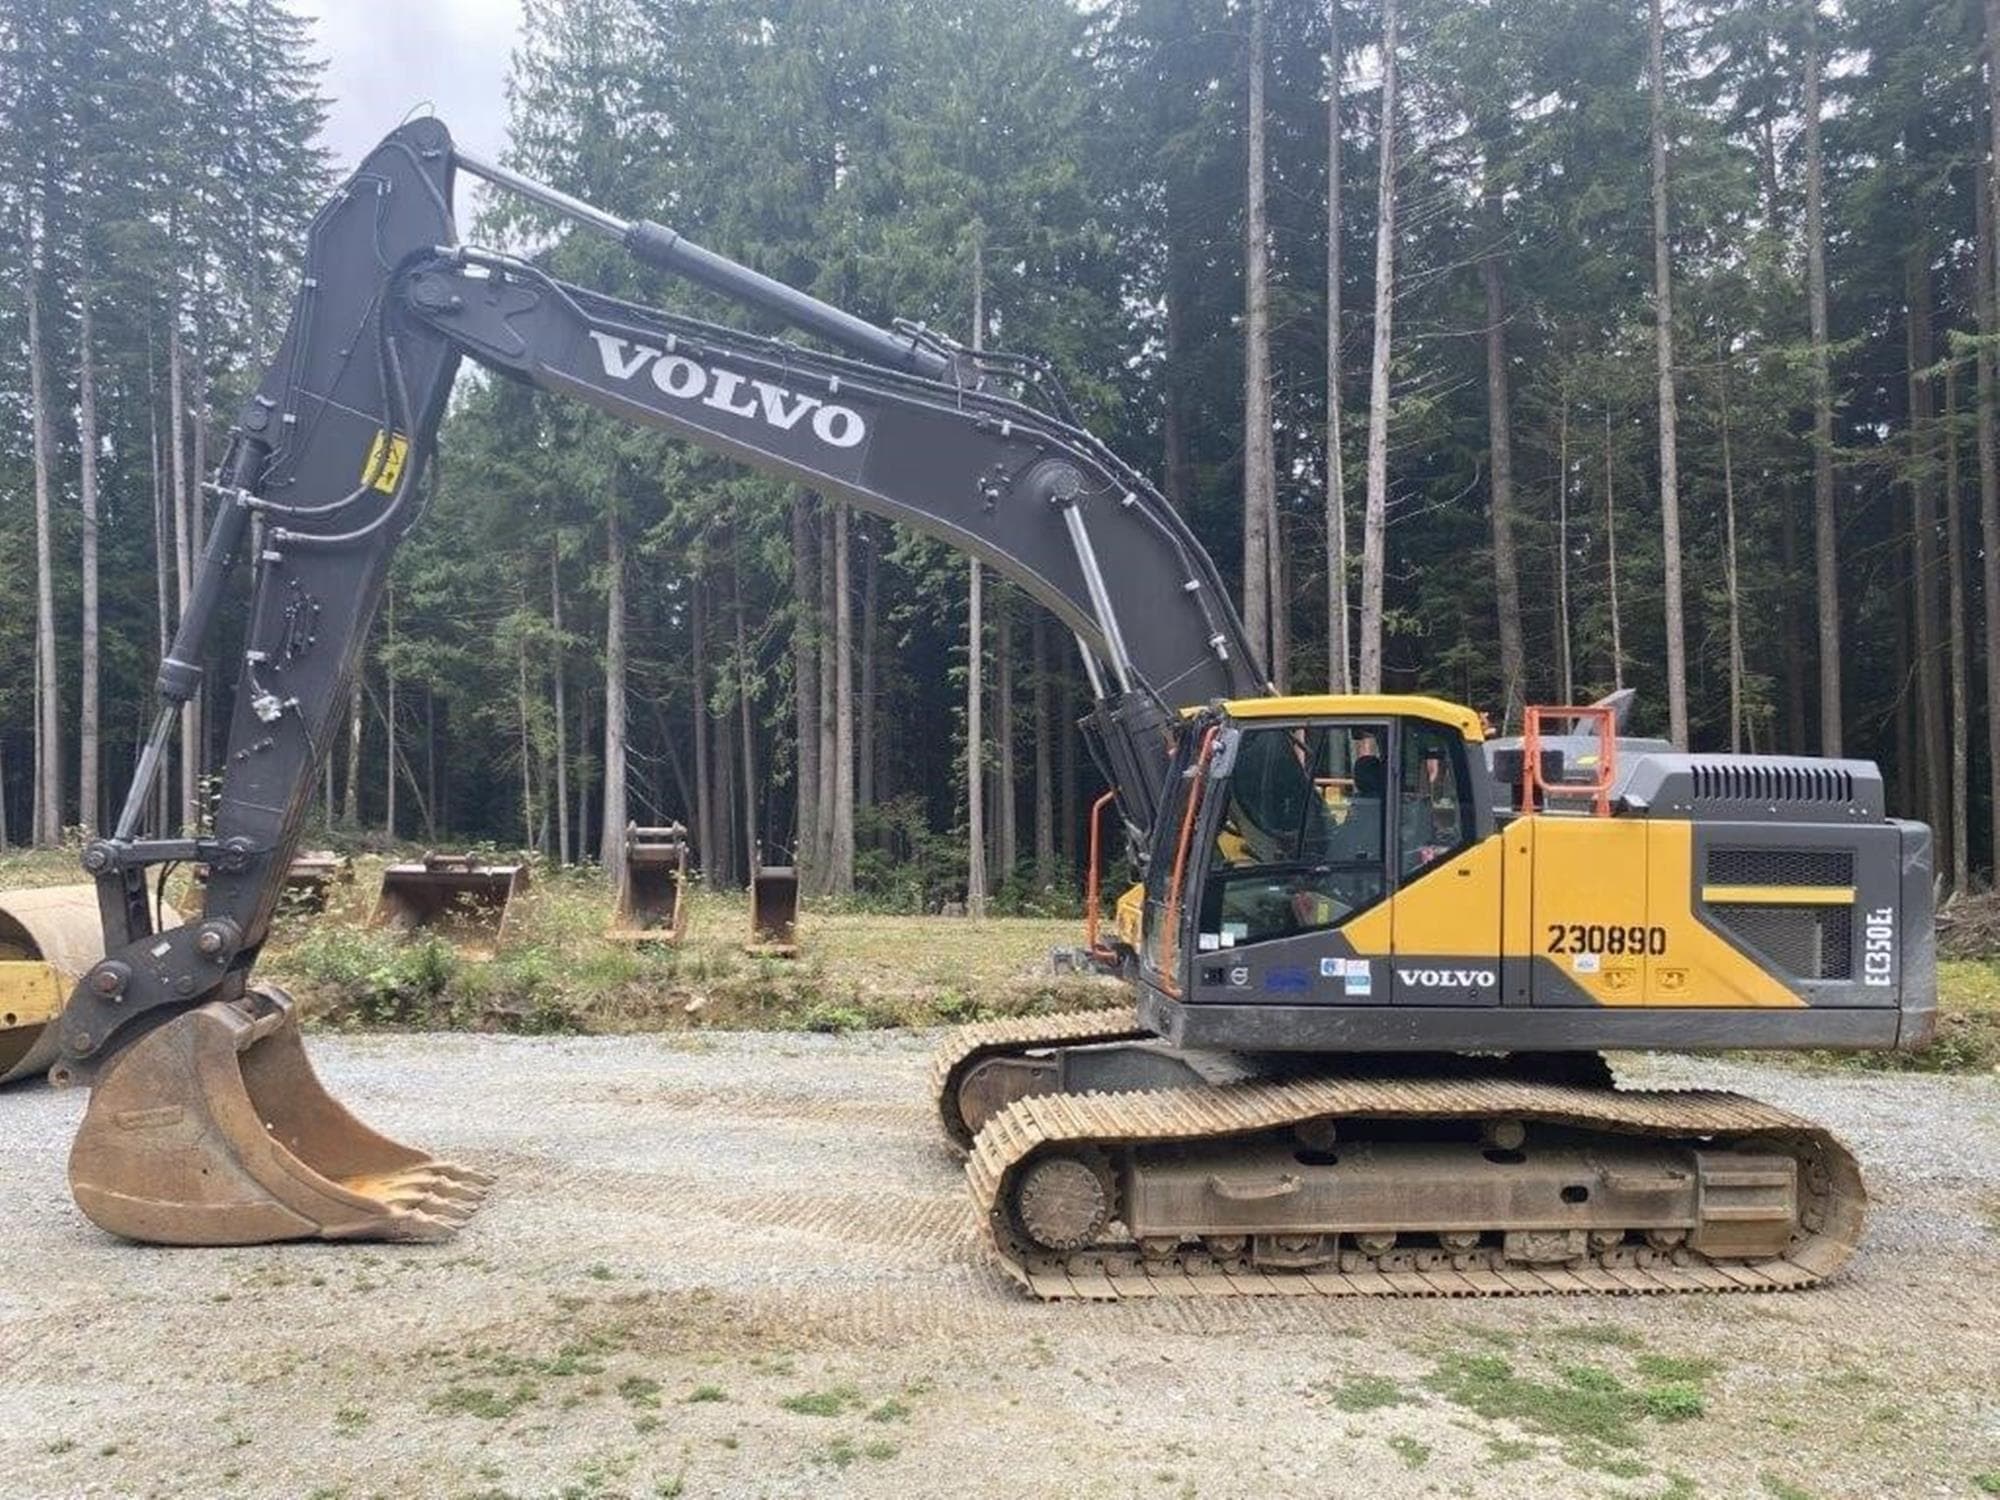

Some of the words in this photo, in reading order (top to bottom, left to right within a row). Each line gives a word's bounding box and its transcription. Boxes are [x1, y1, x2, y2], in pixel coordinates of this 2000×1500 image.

[589, 330, 866, 448] VOLVO
[1548, 924, 1666, 956] 230890
[1397, 969, 1495, 987] VOLVO
